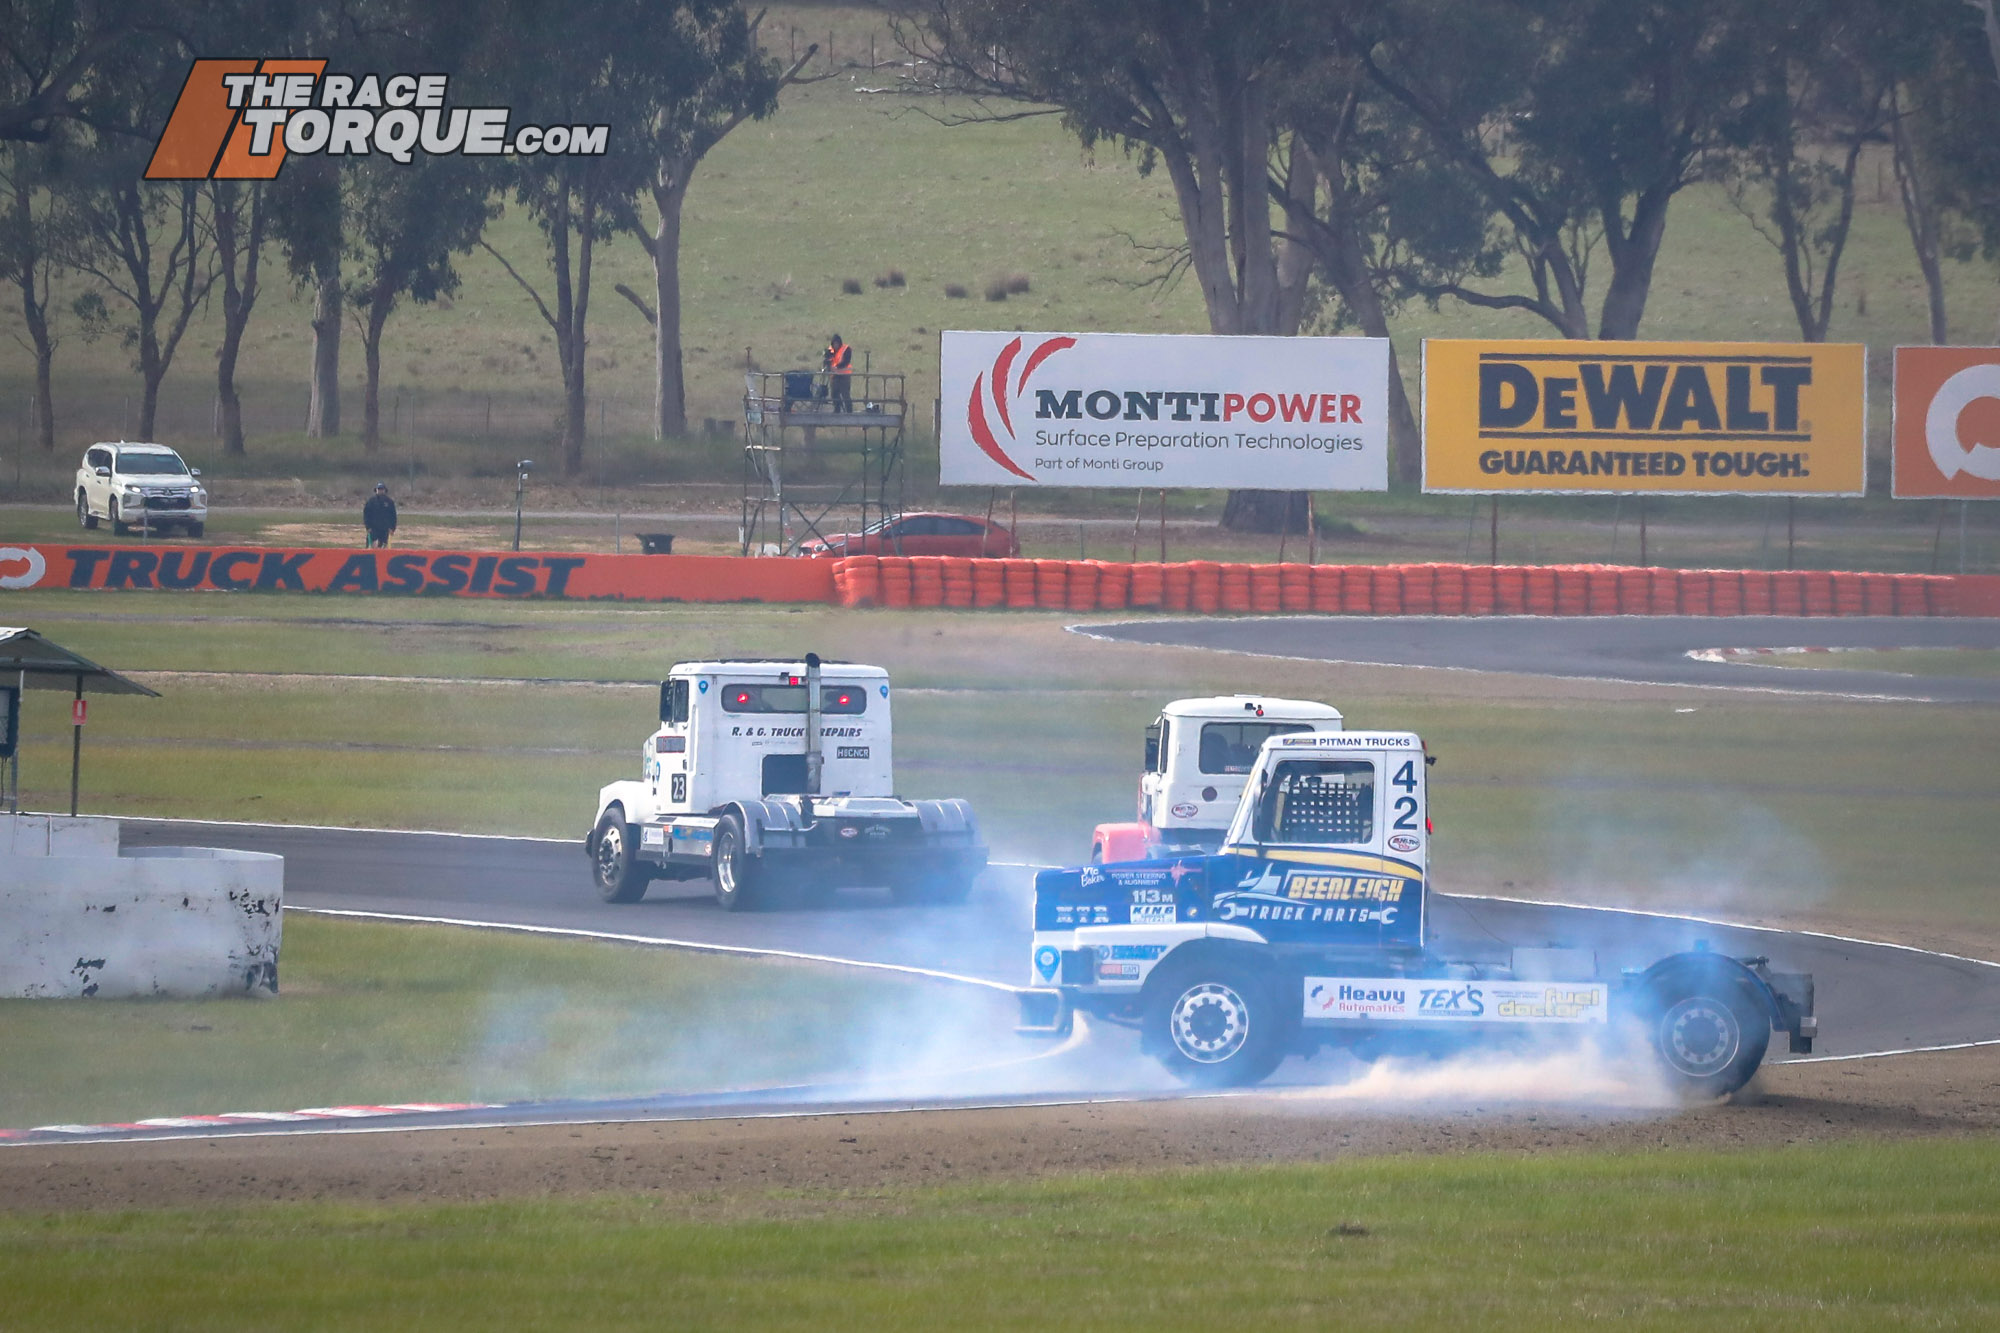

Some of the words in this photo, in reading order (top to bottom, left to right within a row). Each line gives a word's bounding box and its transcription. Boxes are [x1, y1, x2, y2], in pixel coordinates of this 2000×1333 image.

[1035, 430, 1110, 447] Surface
[1116, 431, 1228, 450] Preparation
[1234, 433, 1363, 453] Technologies
[1035, 458, 1062, 469] Part
[1066, 457, 1080, 469] of
[1083, 458, 1119, 470] Monti
[1122, 459, 1164, 471] Group
[1479, 450, 1686, 476] GUARANTEED
[66, 549, 317, 591] TRUCK
[328, 552, 585, 596] ASSIST
[732, 727, 742, 737] R.
[746, 727, 753, 737] &
[757, 728, 767, 737] G.
[771, 727, 805, 737] TRUCK
[1319, 738, 1362, 746] PITMAN
[673, 777, 685, 800] 23
[1288, 876, 1404, 902] BEENLEIGH
[1250, 906, 1304, 921] TRUCK
[1312, 908, 1369, 923] PARTS
[1339, 985, 1405, 1003] Heavy
[1339, 1003, 1405, 1012] Automatics
